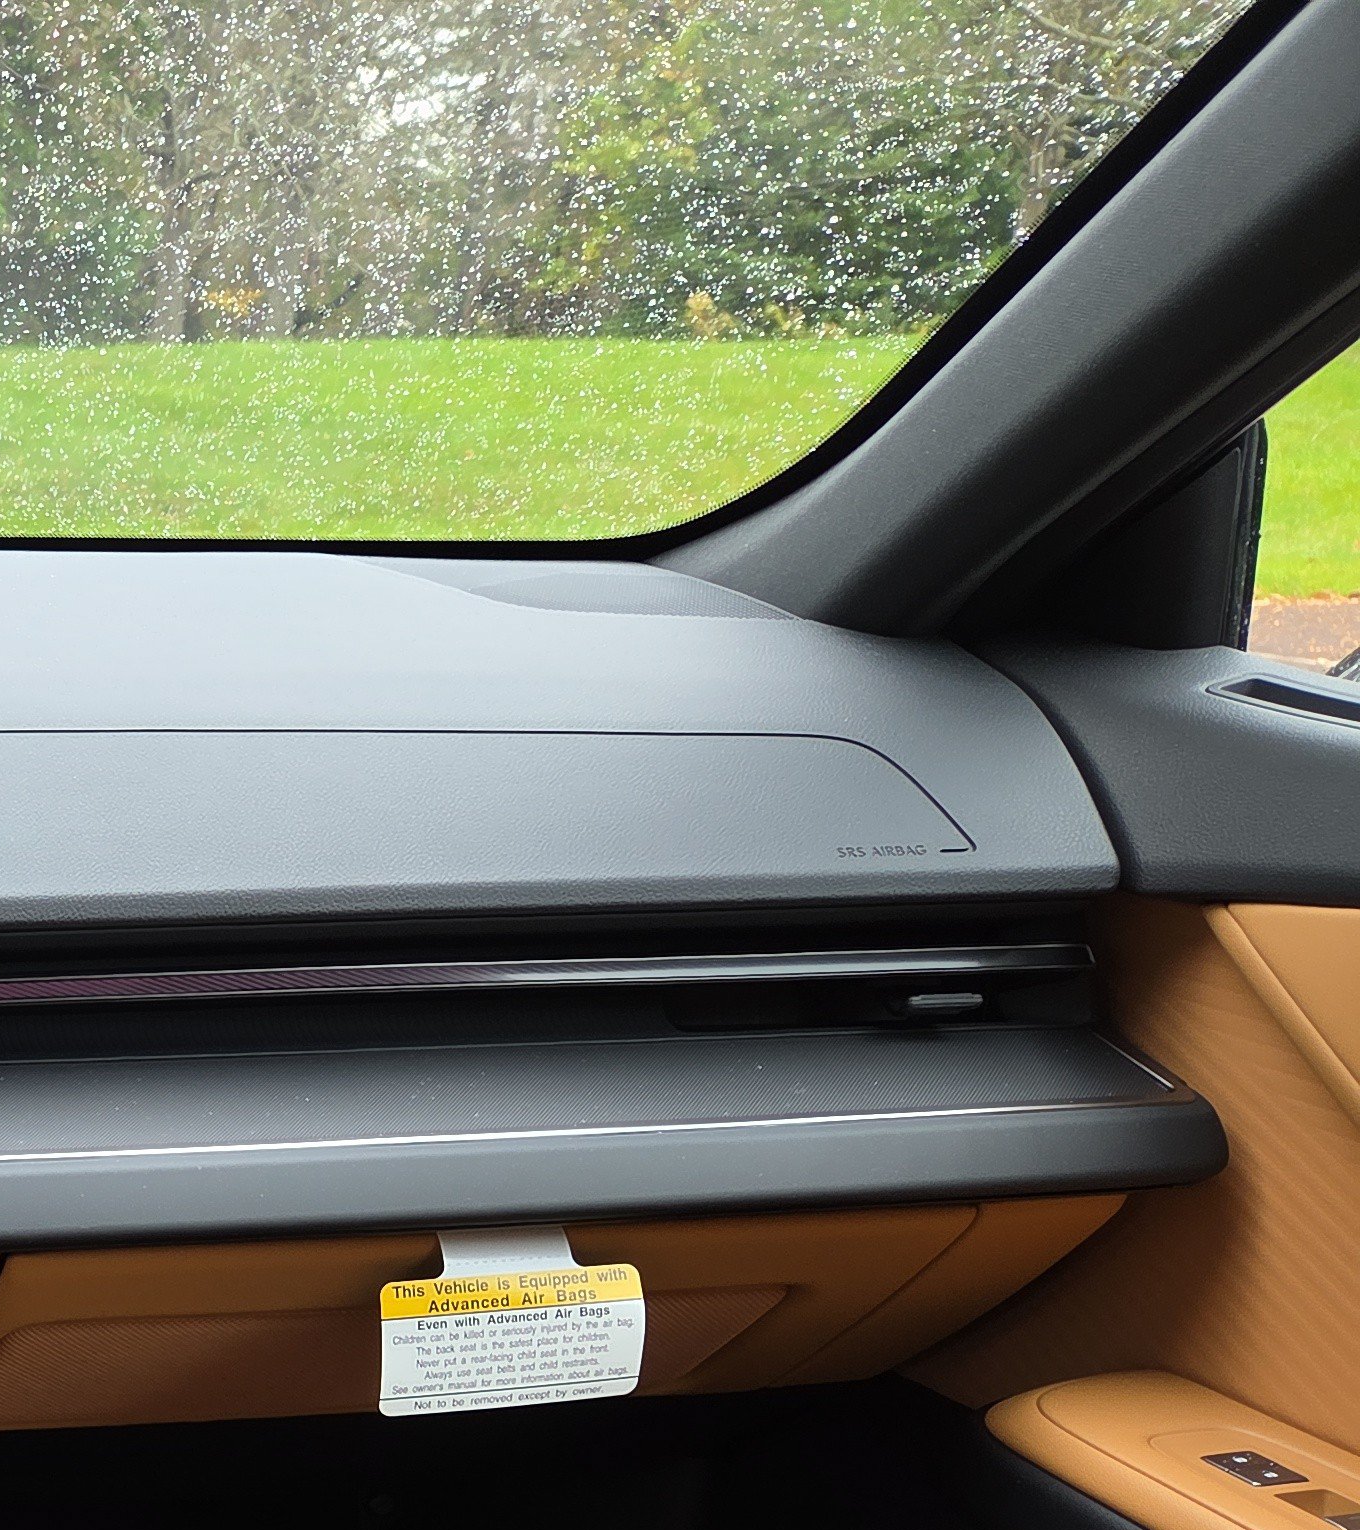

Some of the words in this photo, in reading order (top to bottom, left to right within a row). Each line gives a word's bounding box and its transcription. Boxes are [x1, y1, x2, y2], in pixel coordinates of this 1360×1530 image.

[836, 846, 867, 858] SRS
[872, 844, 927, 857] AIRBAG
[392, 1284, 425, 1299] This
[434, 1279, 489, 1295] Vehicle
[497, 1277, 511, 1290] is
[519, 1271, 589, 1289] Equipped
[597, 1268, 628, 1282] with
[428, 1294, 510, 1313] Advanced
[521, 1291, 545, 1306] Air
[556, 1289, 597, 1302] Bags
[417, 1320, 448, 1331] Even
[454, 1316, 480, 1328] with
[487, 1310, 548, 1326] Advanced
[554, 1308, 573, 1320] Air
[580, 1307, 611, 1318] Bags
[430, 1333, 445, 1342] can
[449, 1332, 460, 1341] be
[489, 1330, 497, 1338] or
[571, 1322, 582, 1331] by
[416, 1346, 431, 1355] The
[413, 1401, 432, 1410] Not
[437, 1400, 447, 1408] to
[452, 1398, 464, 1407] be
[470, 1393, 513, 1405] removed
[518, 1390, 551, 1401] except
[555, 1389, 567, 1398] by
